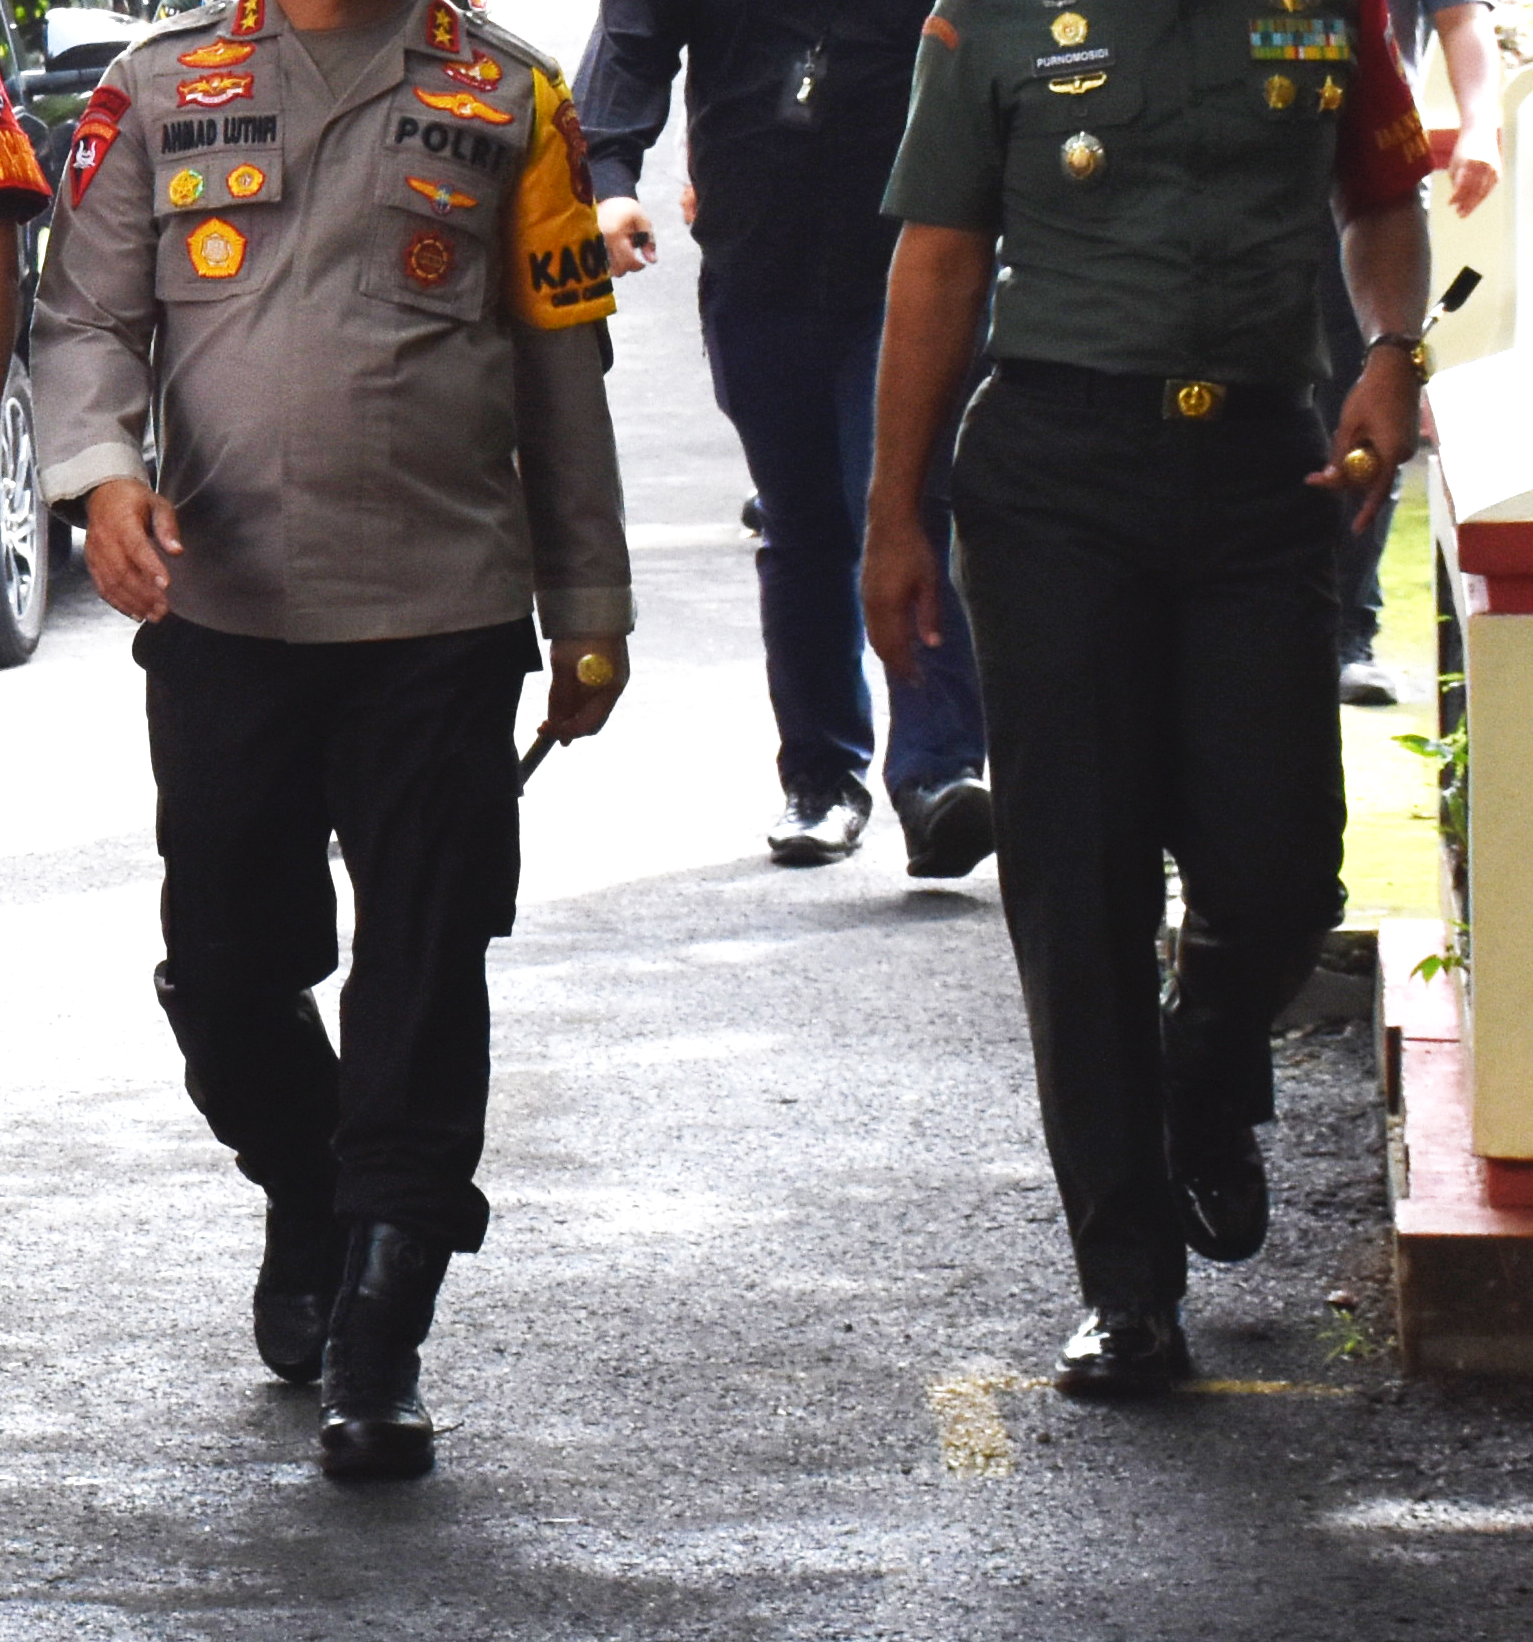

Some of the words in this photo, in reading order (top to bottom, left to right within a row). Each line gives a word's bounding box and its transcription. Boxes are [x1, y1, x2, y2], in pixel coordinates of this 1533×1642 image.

[161, 118, 217, 155] AHMAD
[223, 115, 277, 145] LUTHFI
[395, 115, 507, 174] POLRI
